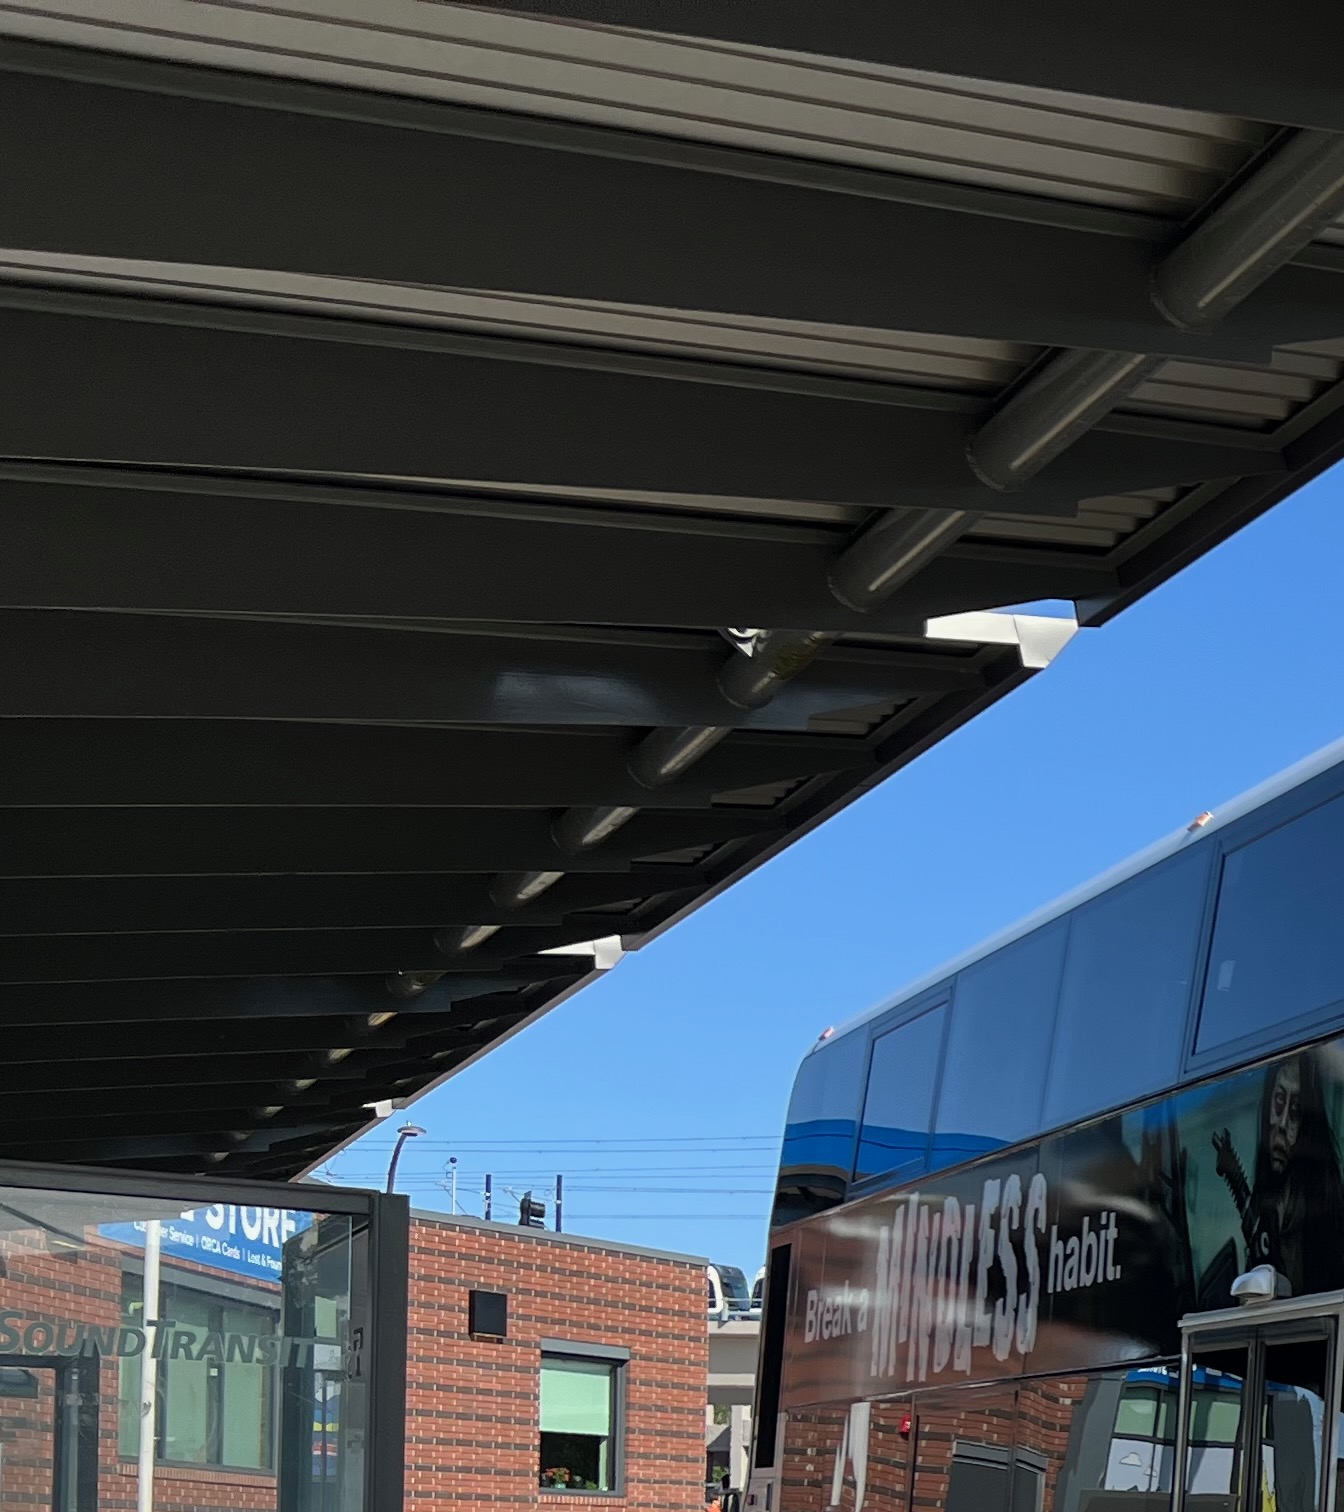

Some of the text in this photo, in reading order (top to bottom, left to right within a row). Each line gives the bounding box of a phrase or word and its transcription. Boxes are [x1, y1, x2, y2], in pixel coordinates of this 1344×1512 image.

[804, 1172, 1122, 1383] Break a MINDLESS habit.
